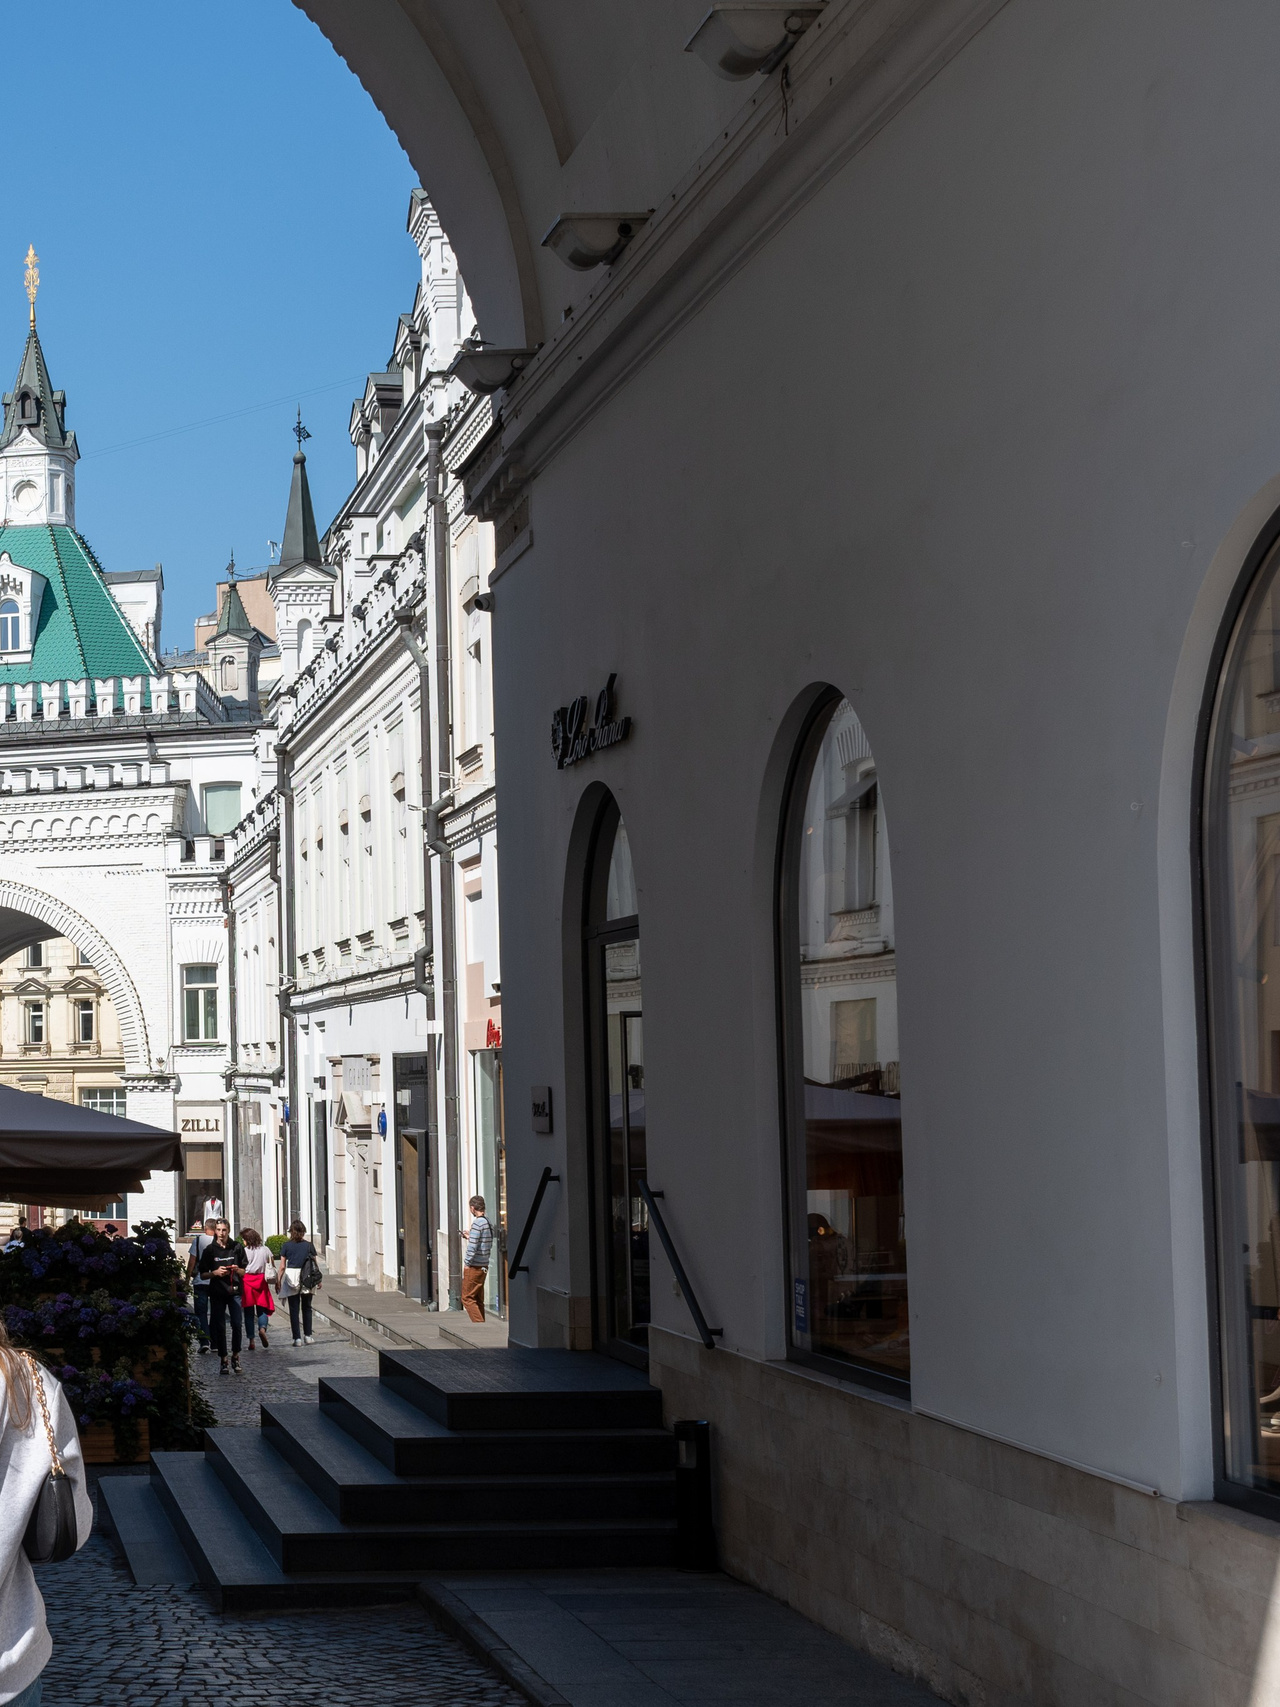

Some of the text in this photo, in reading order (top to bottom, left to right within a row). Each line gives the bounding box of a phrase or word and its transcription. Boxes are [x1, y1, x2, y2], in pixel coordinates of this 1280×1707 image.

[563, 682, 628, 767] Loro Piana
[181, 1118, 220, 1132] ZILLI
[795, 1282, 805, 1295] SHOP
[796, 1304, 805, 1318] FREE
